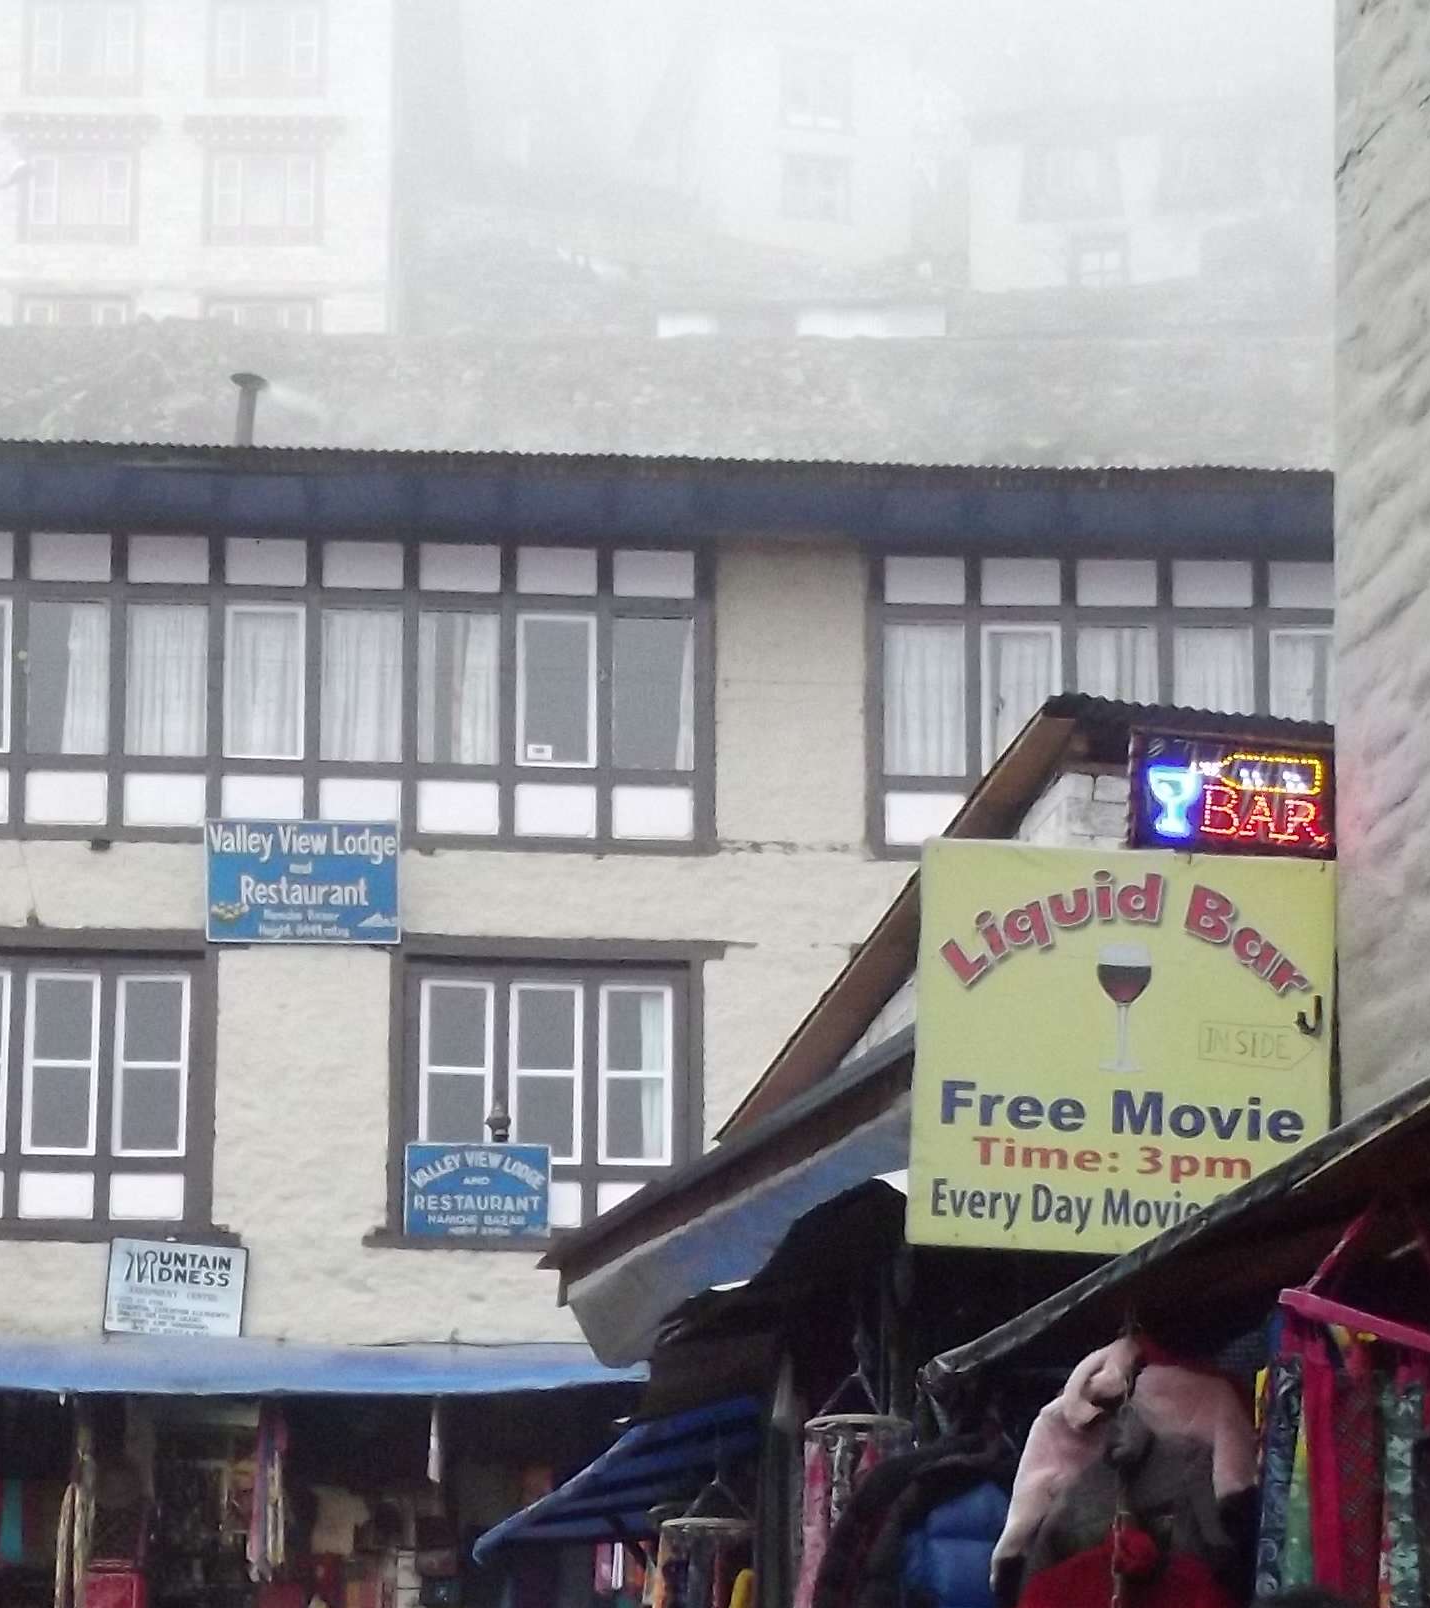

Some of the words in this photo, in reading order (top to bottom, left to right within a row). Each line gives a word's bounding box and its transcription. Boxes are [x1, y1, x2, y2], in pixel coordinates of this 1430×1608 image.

[1199, 783, 1328, 844] BAR
[208, 824, 273, 863] Valley
[278, 824, 327, 856] View
[331, 826, 397, 865] Lodge
[240, 875, 369, 907] Restaurant
[938, 868, 1167, 988] Liquid
[1182, 884, 1311, 996] Bar
[940, 1080, 1086, 1132] Free
[1111, 1088, 1305, 1144] Movie
[410, 1152, 461, 1190] VALLEY
[463, 1150, 504, 1169] VIEW
[502, 1155, 547, 1191] LODGE
[462, 1176, 491, 1186] AND
[973, 1136, 1121, 1174] Time:
[1136, 1147, 1252, 1183] 3pm
[413, 1194, 541, 1213] RESTAURANT
[930, 1177, 1021, 1233] Every
[1031, 1183, 1093, 1235] Day
